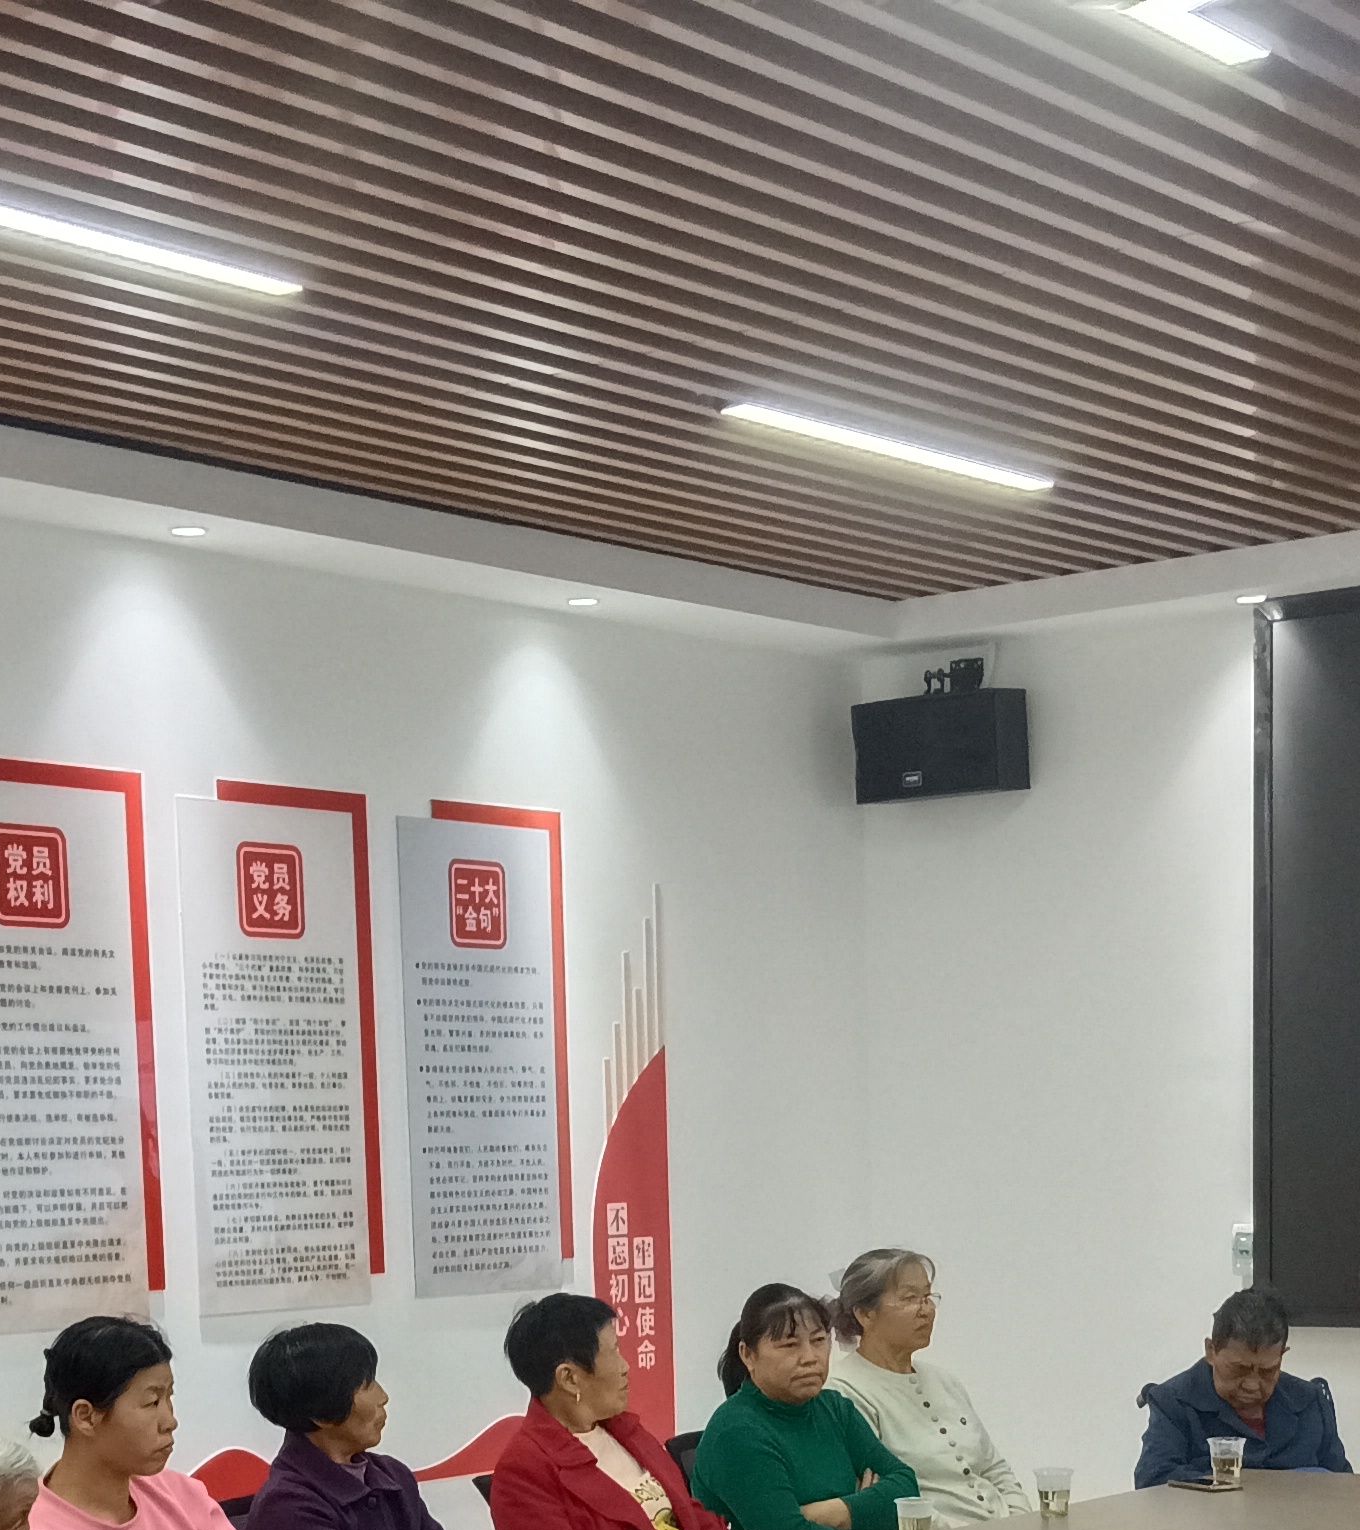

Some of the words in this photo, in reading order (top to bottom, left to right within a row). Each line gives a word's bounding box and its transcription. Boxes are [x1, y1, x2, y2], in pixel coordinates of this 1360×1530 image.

[5, 843, 52, 876] 党员
[250, 861, 290, 890] 党员
[7, 877, 53, 909] 权利
[456, 877, 498, 904] 二十大
[252, 893, 292, 921] 义务
[608, 1205, 630, 1337] 不忘初心
[635, 1239, 656, 1370] 牢记使命
